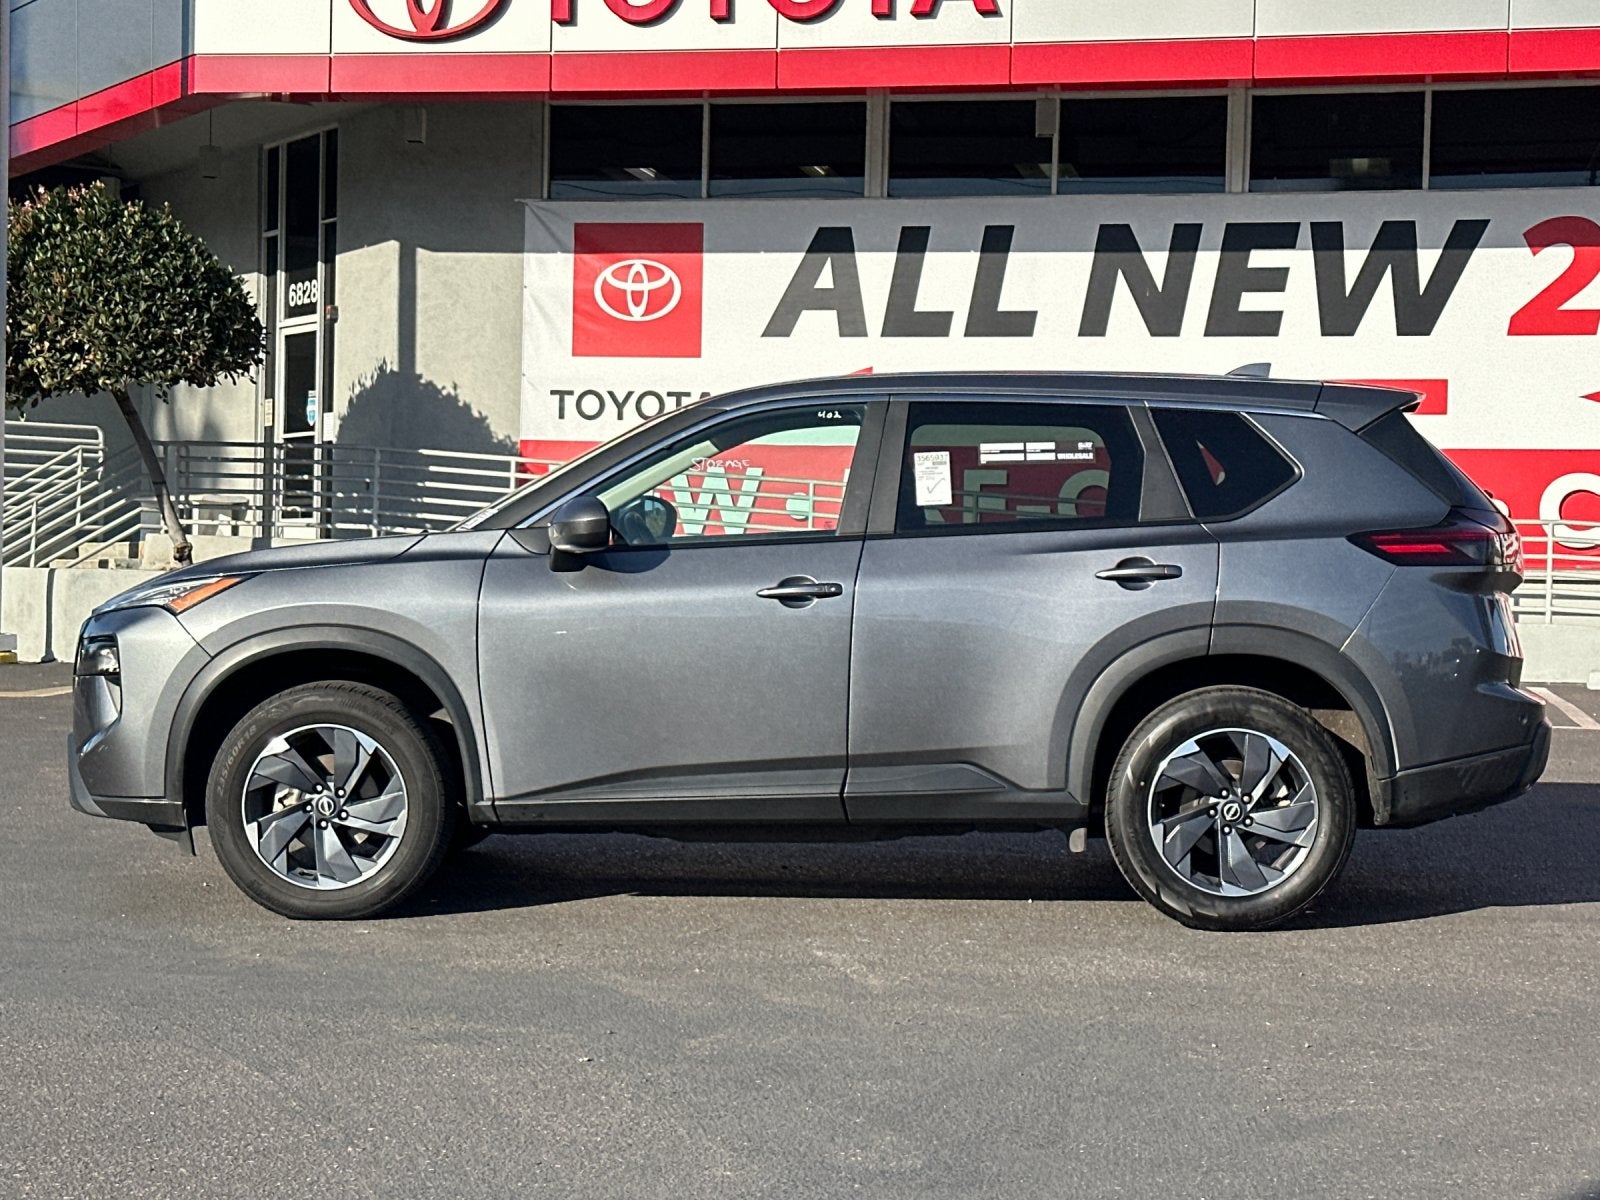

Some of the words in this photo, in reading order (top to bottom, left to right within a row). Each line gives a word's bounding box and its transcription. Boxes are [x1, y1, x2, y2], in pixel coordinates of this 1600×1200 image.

[289, 279, 318, 307] 6828
[761, 225, 1038, 337] ALL
[1078, 219, 1491, 337] NEW
[550, 389, 712, 421] TOYOT
